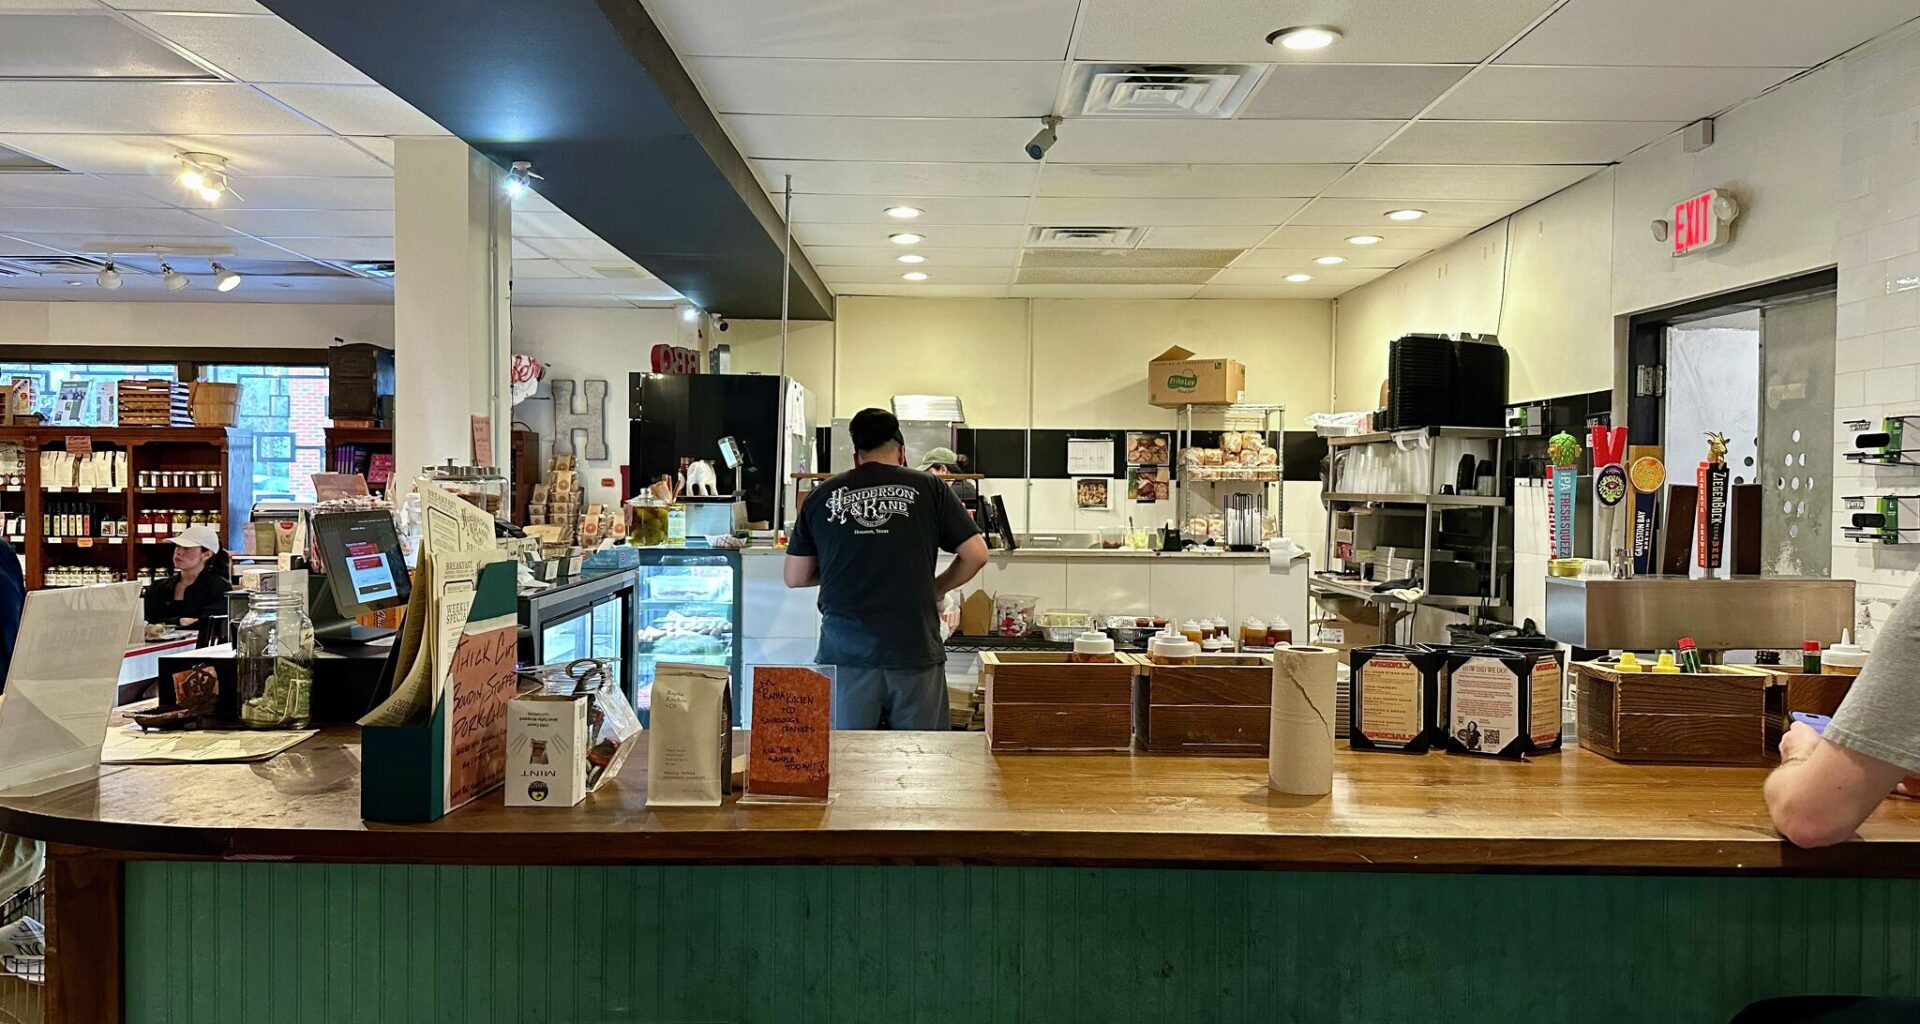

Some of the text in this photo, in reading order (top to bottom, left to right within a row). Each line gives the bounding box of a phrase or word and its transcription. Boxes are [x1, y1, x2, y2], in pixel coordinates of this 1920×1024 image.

[1674, 193, 1712, 252] EXIT
[551, 379, 607, 460] H
[1560, 472, 1572, 491] IPA
[1710, 471, 1727, 524] ZIEGENBOCK
[825, 486, 915, 524] HENDERSON
[850, 498, 908, 519] & KANE
[1547, 478, 1557, 556] DESCHUTES
[1559, 492, 1572, 522] FRESH
[1634, 510, 1646, 557] GALVESTON BAY
[445, 561, 473, 571] BREAKFAST
[446, 612, 467, 624] SPECIA
[455, 631, 518, 672] THICK CUT
[452, 681, 484, 714] BOUDIN
[452, 698, 485, 747] PORK
[486, 700, 508, 728] CHO
